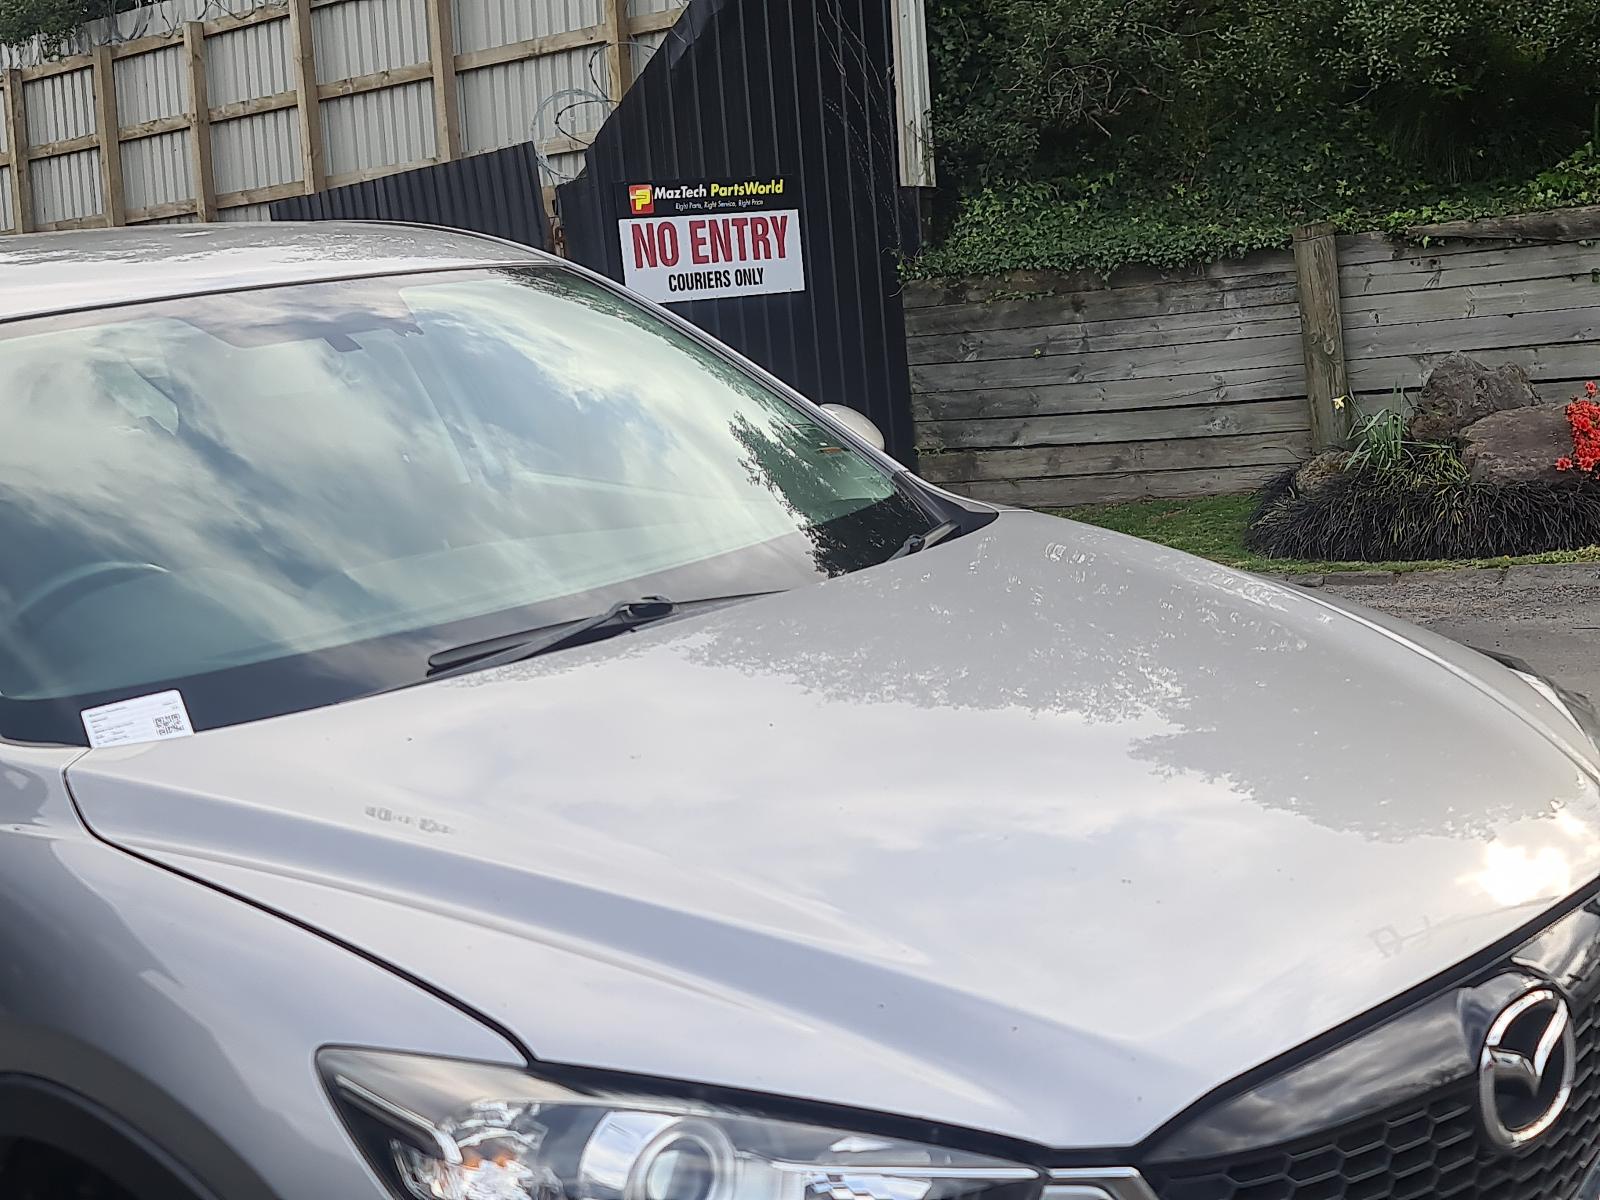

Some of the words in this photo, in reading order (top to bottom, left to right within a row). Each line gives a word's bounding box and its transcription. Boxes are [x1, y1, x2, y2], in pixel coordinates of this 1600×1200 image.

[654, 183, 707, 200] MazTech
[710, 179, 784, 197] PartsWorld
[675, 202, 689, 211] Right
[704, 201, 717, 210] Right
[738, 198, 751, 208] Right
[751, 198, 764, 206] Price
[631, 221, 680, 269] NO
[689, 215, 788, 265] ENTRY
[668, 270, 731, 292] COURIERS
[735, 267, 764, 287] ONLY
